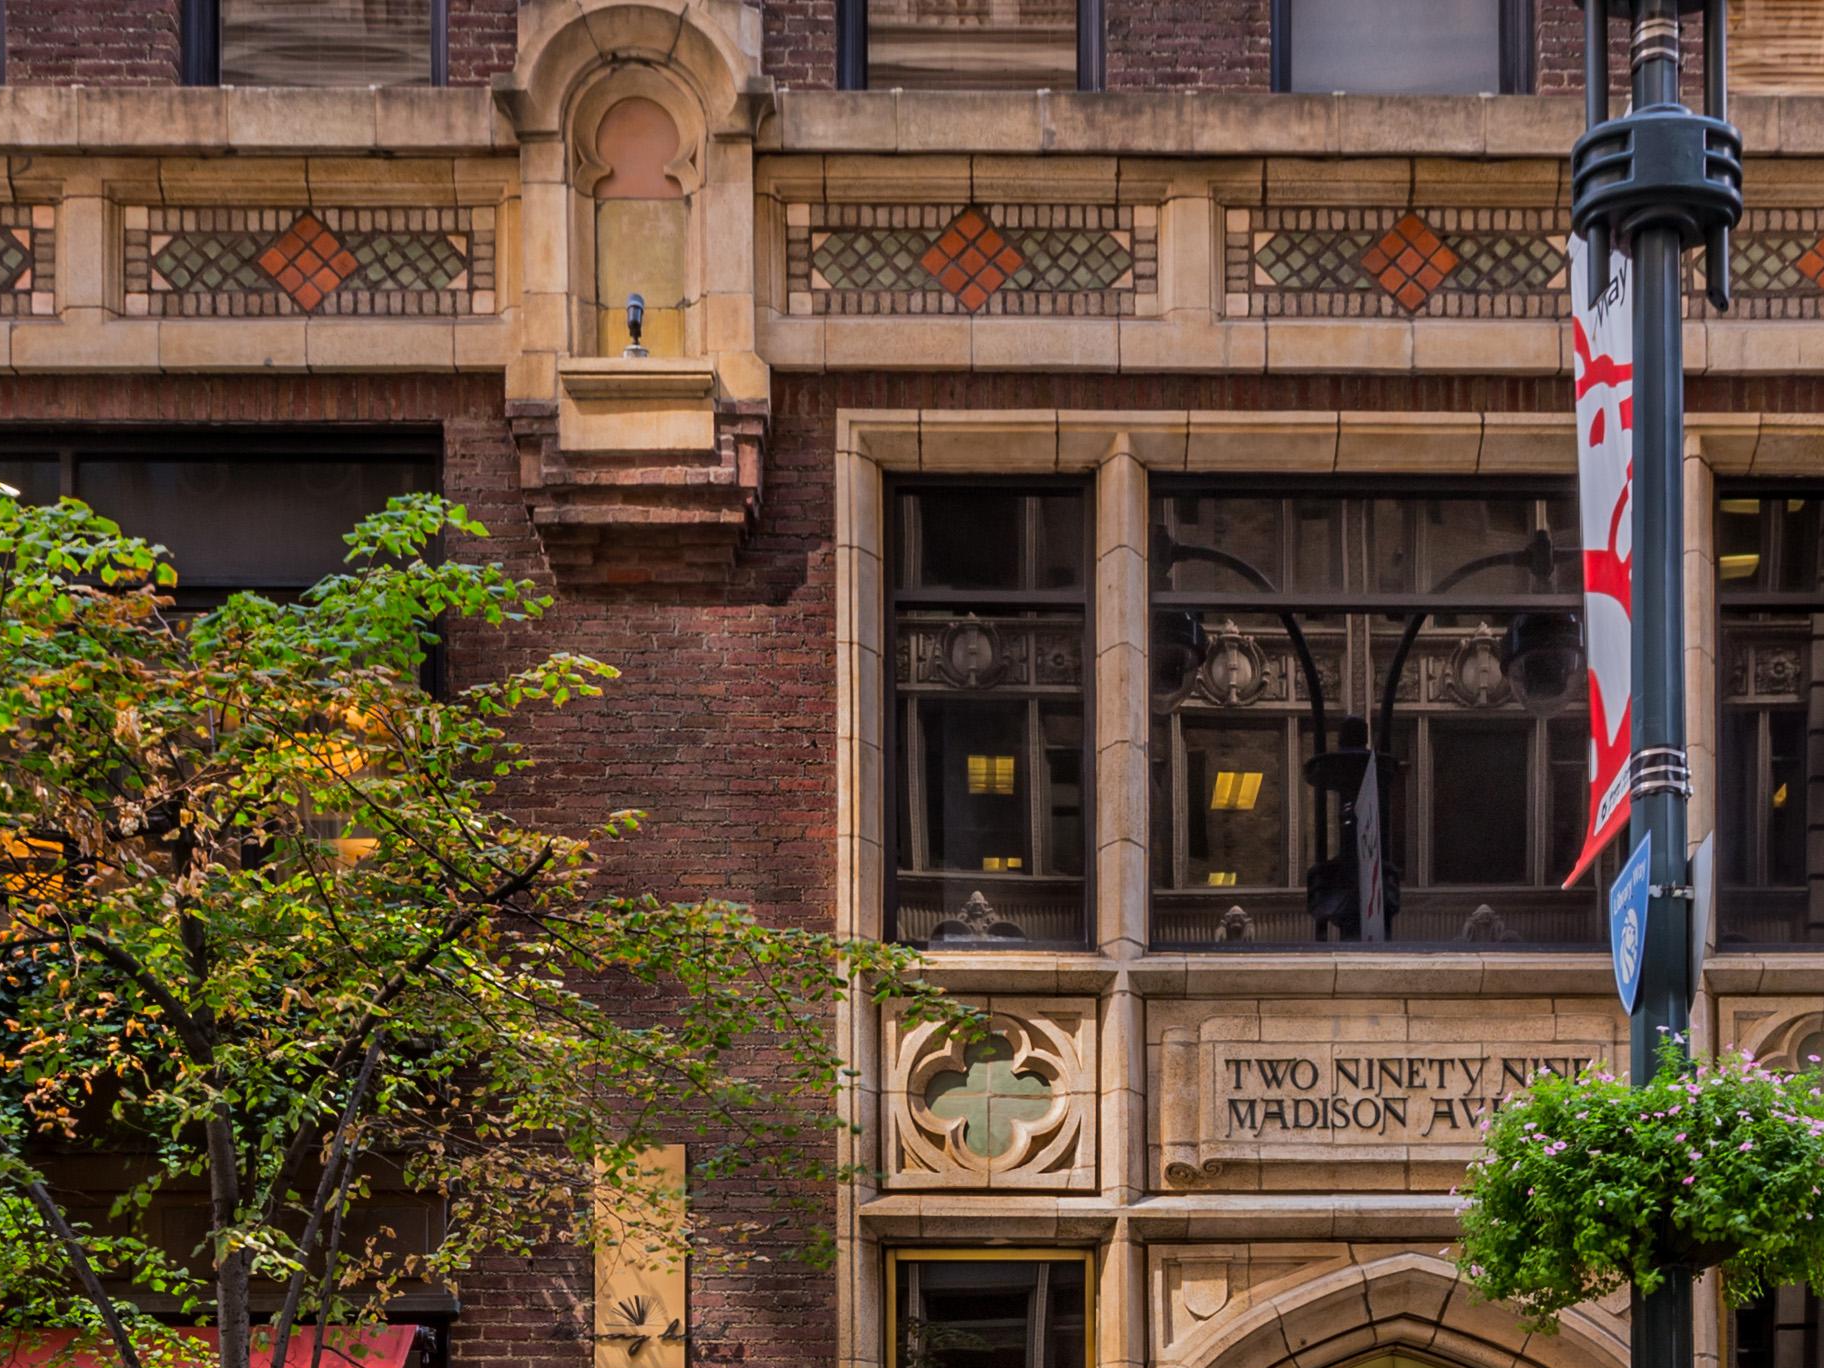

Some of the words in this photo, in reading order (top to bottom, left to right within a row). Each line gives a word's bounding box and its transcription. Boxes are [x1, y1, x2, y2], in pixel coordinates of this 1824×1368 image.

[1225, 1057, 1319, 1090] TWO
[1333, 1056, 1491, 1097] NINETY
[1226, 1097, 1409, 1138] MADISON
